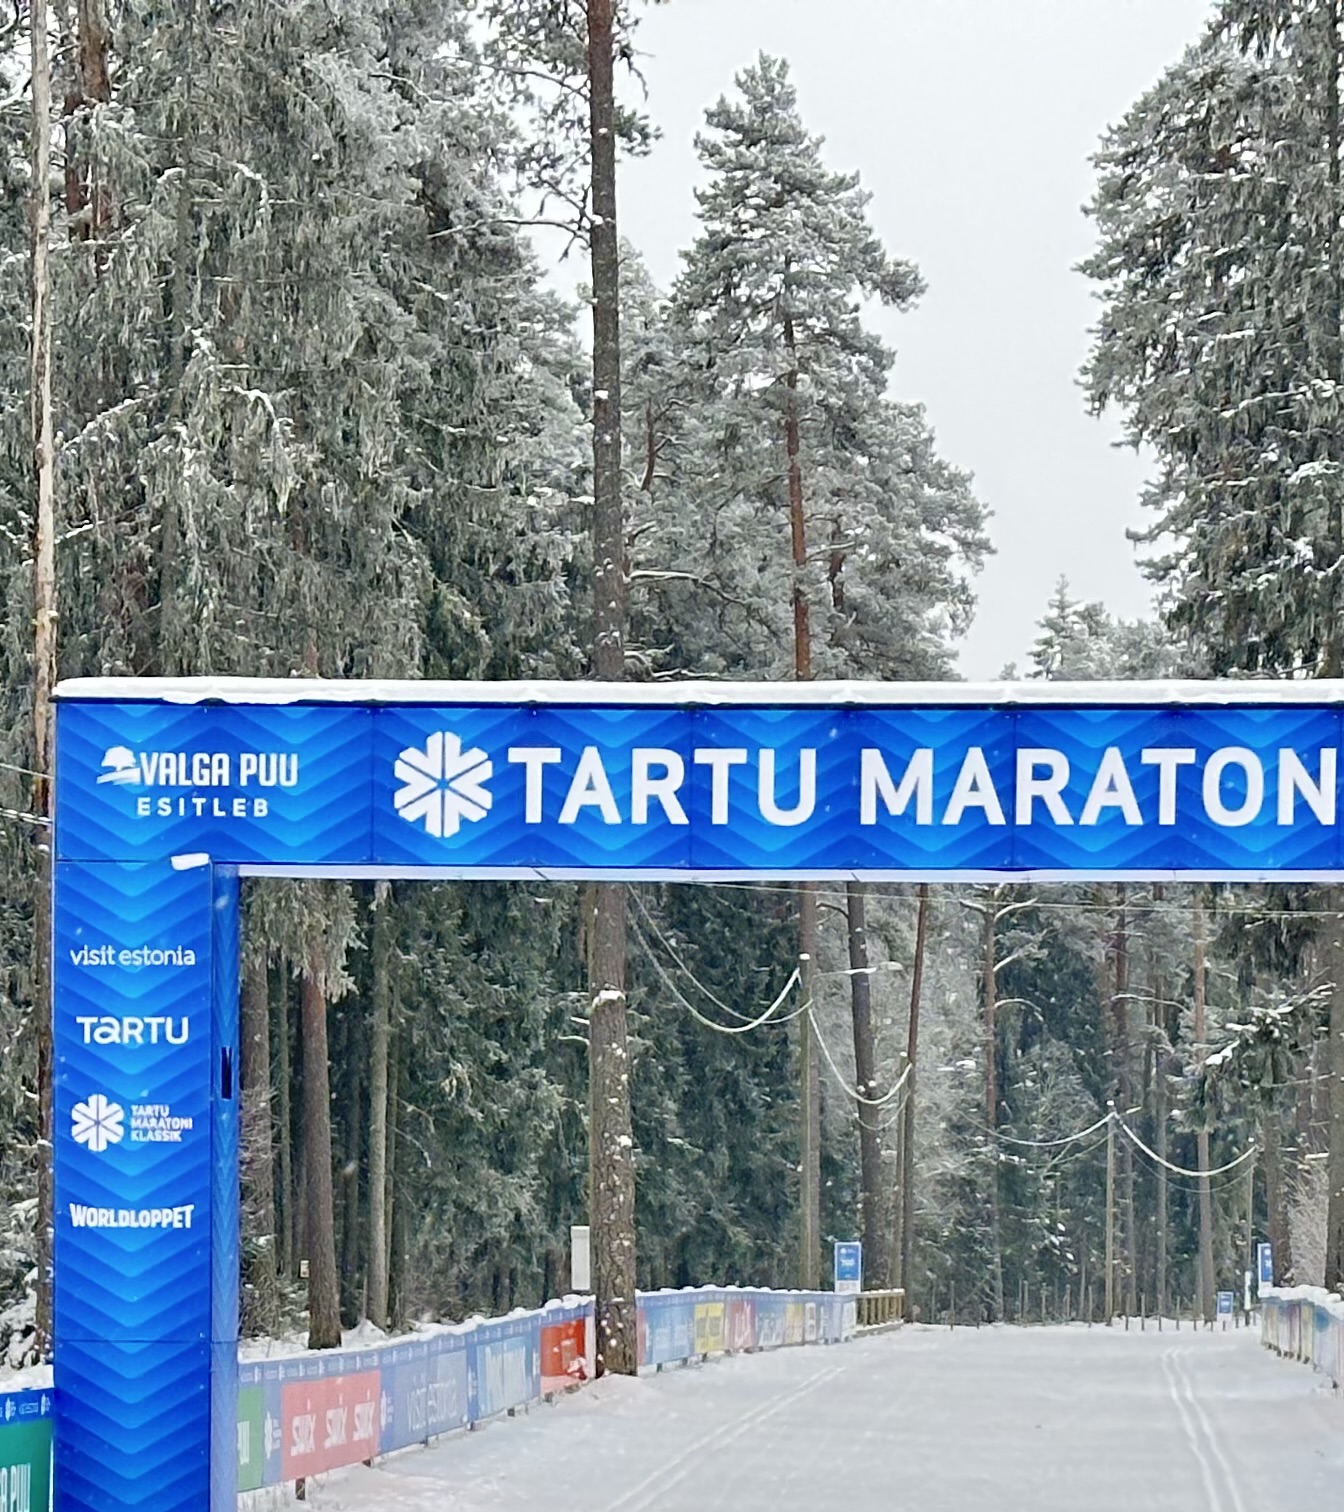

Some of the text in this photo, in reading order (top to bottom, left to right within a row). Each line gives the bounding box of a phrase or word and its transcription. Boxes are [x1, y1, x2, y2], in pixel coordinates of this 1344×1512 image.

[139, 752, 299, 788] VALGA PUU
[507, 746, 1337, 827] TARTU MARATON
[136, 797, 269, 818] ESITLEB
[69, 944, 196, 966] visit estonia
[130, 1104, 170, 1118] TARTU
[68, 1203, 195, 1229] WORLDLOPPET
